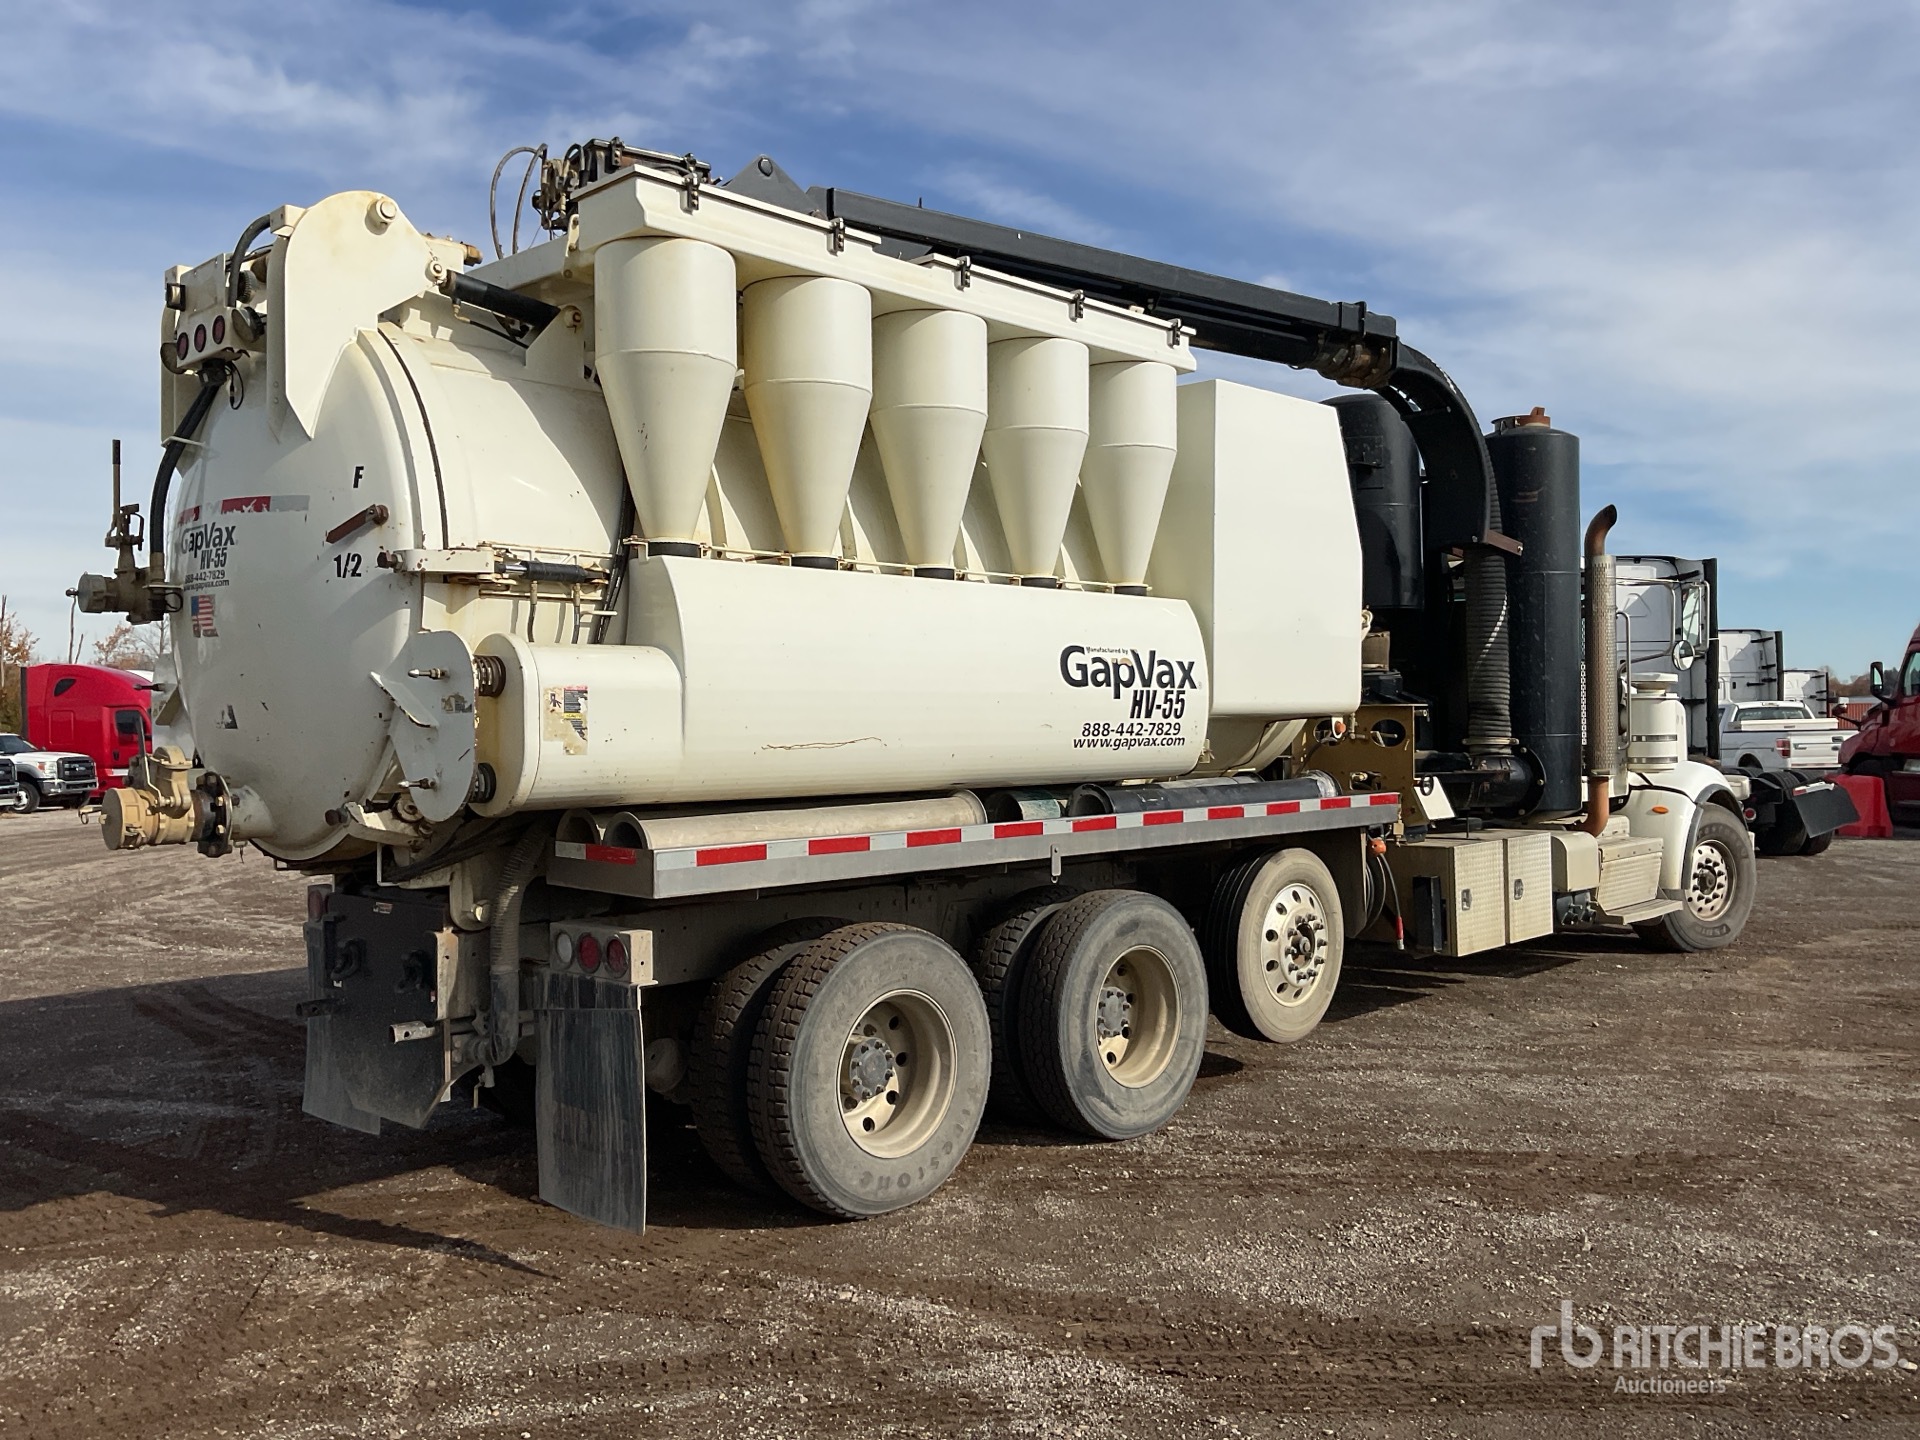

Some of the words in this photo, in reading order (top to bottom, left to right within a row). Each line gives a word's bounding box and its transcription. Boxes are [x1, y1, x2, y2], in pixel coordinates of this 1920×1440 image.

[353, 466, 364, 488] F
[181, 522, 236, 558] GapVax
[200, 547, 228, 570] HV-55
[333, 553, 362, 578] 1/2
[1060, 645, 1198, 699] GapVax
[1130, 689, 1186, 719] HV-55
[1082, 722, 1181, 737] 888-442-7829
[1073, 736, 1186, 751] www.gapvax.com
